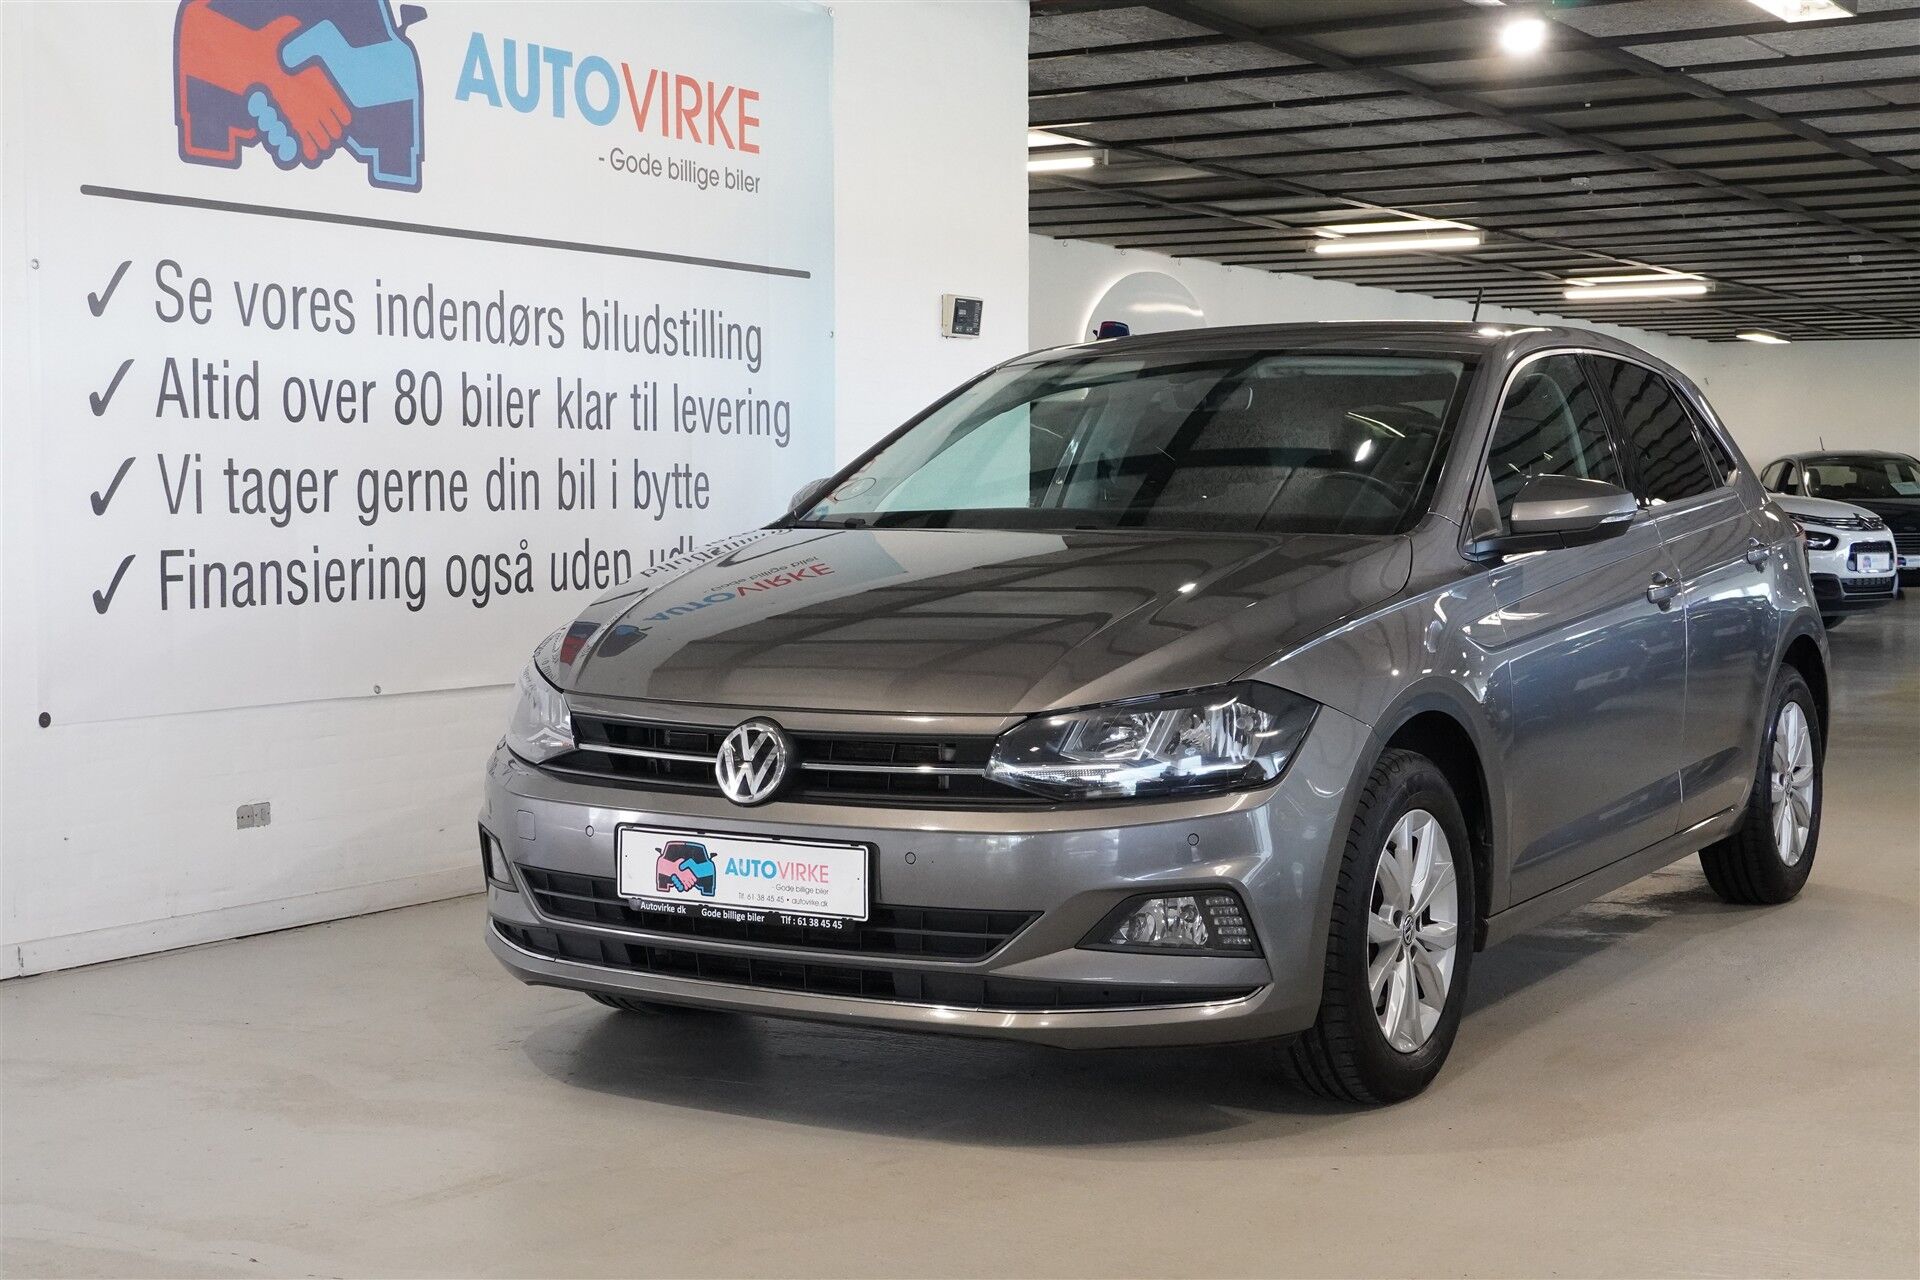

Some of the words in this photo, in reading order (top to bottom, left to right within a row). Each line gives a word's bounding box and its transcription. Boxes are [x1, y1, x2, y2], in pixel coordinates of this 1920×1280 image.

[455, 31, 760, 154] AUTOVIRKE
[609, 147, 662, 177] Gode
[668, 157, 720, 191] billige
[725, 166, 760, 194] biler
[155, 259, 212, 325] Se
[234, 281, 355, 335] vores
[376, 280, 565, 349] indendørs
[582, 297, 762, 374] biludstilling
[155, 357, 260, 422] Altid
[282, 376, 377, 425] over
[394, 368, 443, 428] 80
[461, 371, 541, 430] biler
[557, 376, 618, 431] klar
[630, 381, 657, 432] til
[673, 383, 792, 448] levering
[157, 453, 203, 515] Vi
[223, 458, 339, 528] tager
[357, 468, 468, 528] gerne
[485, 456, 540, 512] din
[558, 457, 595, 511] bil
[610, 460, 617, 511] i
[633, 458, 710, 522] bytte
[160, 548, 426, 613] Finansiering
[445, 540, 535, 610] også
[551, 537, 632, 593] uden
[725, 857, 829, 884] AUTOVIRKE
[776, 884, 793, 893] Gode
[641, 902, 675, 913] Autovirke
[701, 908, 721, 918] Gode
[723, 910, 745, 922] billige
[747, 912, 765, 922] biler
[757, 894, 765, 902] 38
[766, 895, 775, 903] 45
[776, 896, 785, 904] 45
[781, 915, 792, 924] Tlf
[797, 917, 807, 926] 61
[809, 918, 819, 927] 38
[821, 920, 831, 928] 45
[832, 920, 843, 929] 45
